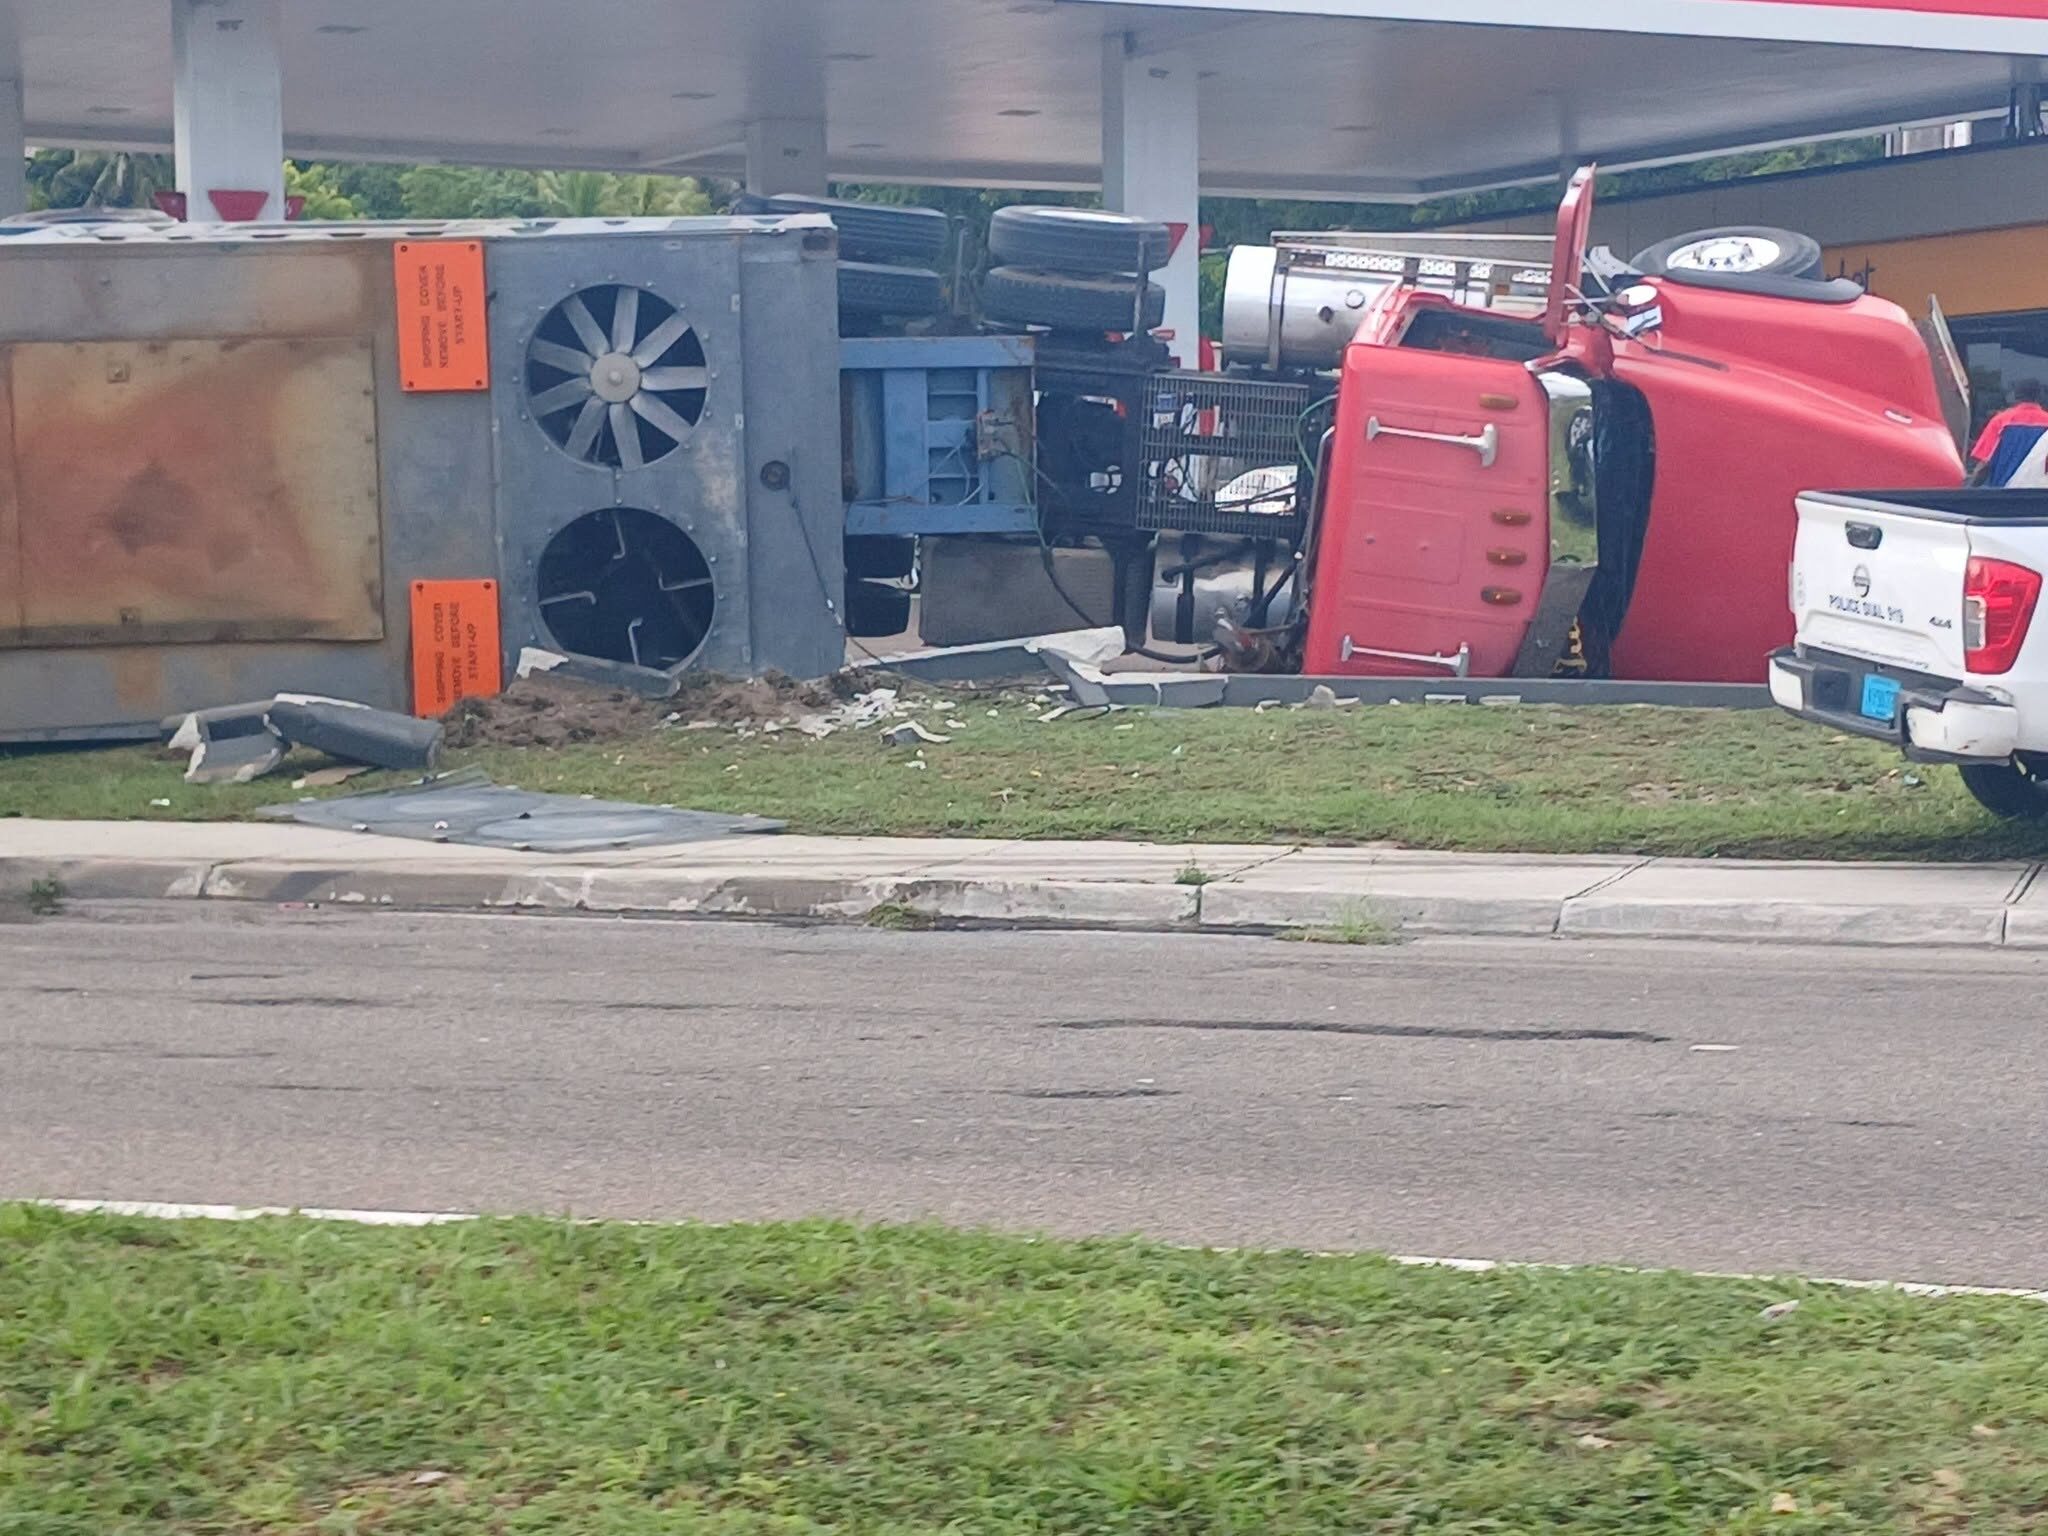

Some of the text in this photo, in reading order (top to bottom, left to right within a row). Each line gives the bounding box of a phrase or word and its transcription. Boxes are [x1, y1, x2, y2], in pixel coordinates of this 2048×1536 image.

[419, 265, 429, 306] COVER
[435, 264, 448, 368] REMOVE BEFORE
[452, 285, 464, 344] START-UP
[433, 603, 444, 642] COVER
[449, 602, 461, 648] BEFORE
[1828, 594, 1860, 614] POLICE
[467, 623, 478, 680] START-UP
